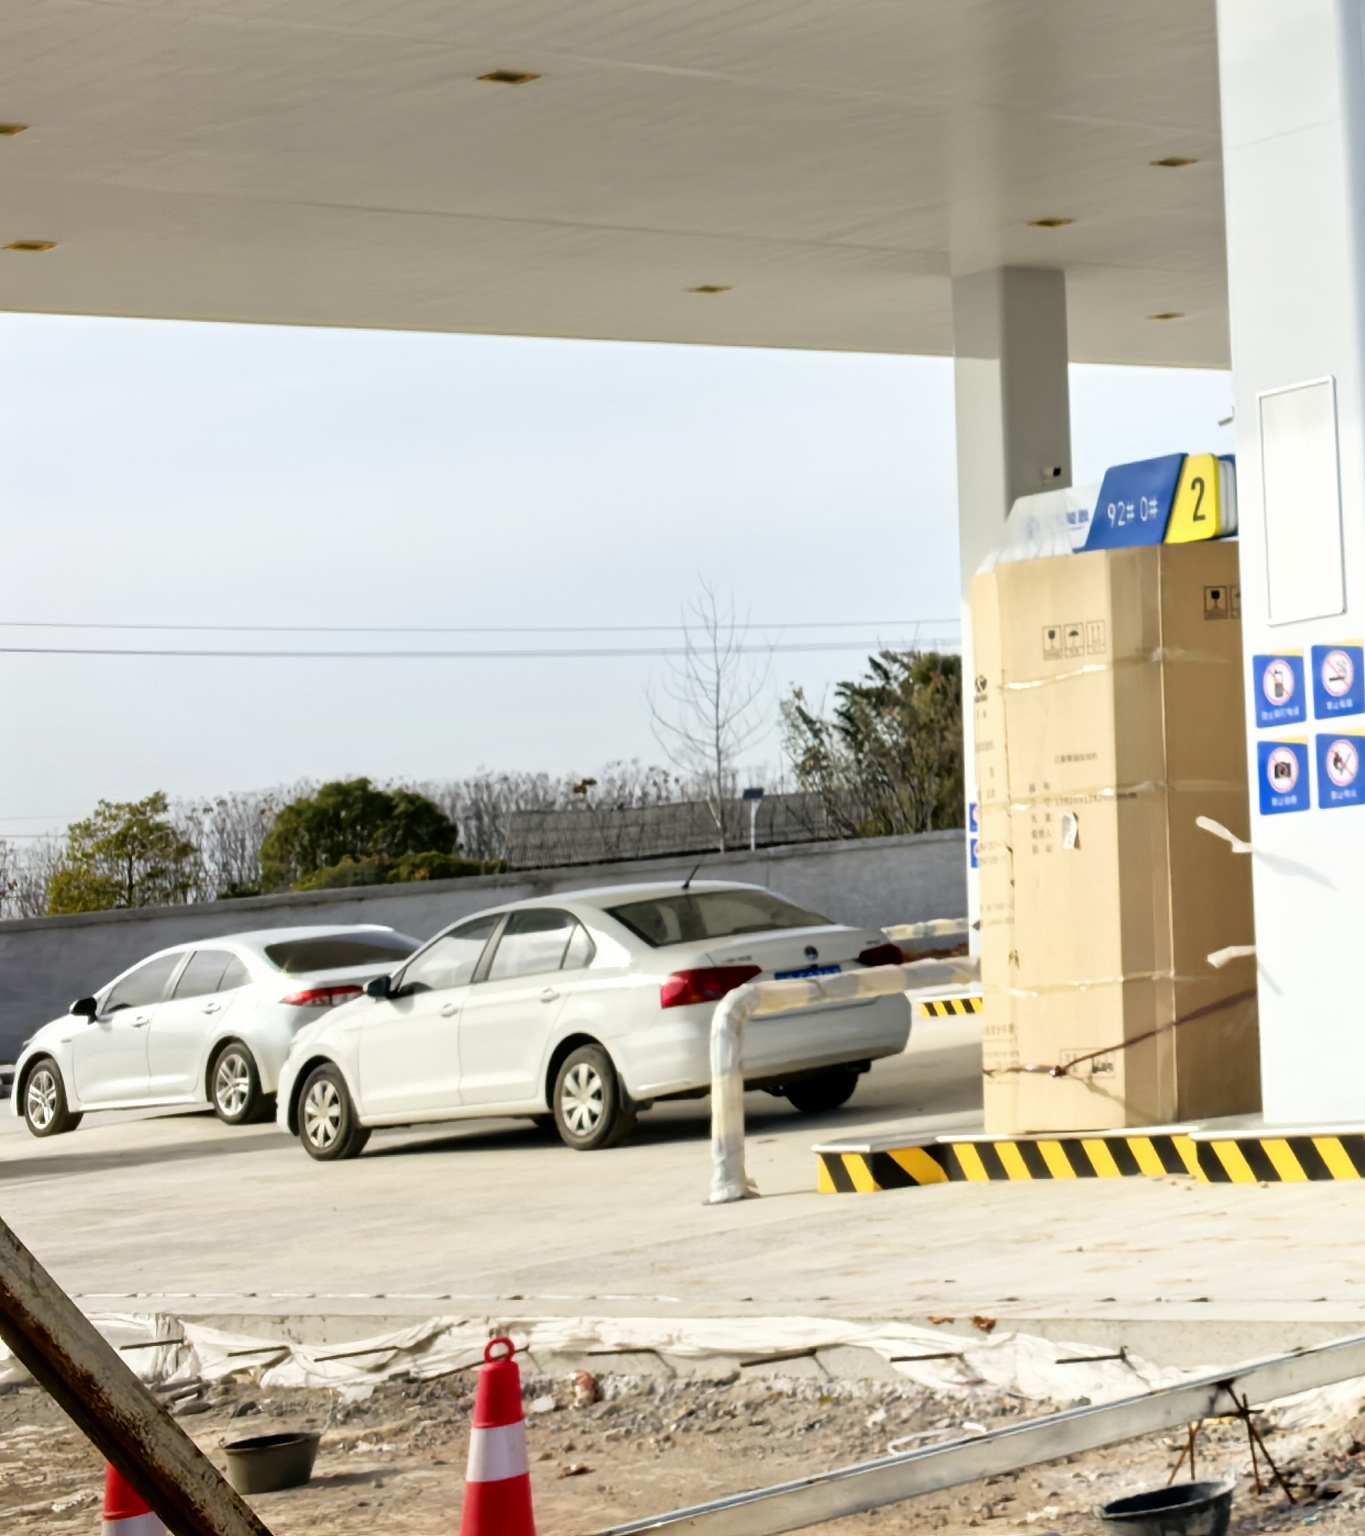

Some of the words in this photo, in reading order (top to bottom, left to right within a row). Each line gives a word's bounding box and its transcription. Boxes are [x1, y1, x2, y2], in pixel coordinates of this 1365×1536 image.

[1107, 501, 1135, 528] 92#
[1140, 495, 1159, 522] 0#
[1190, 476, 1206, 522] 2
